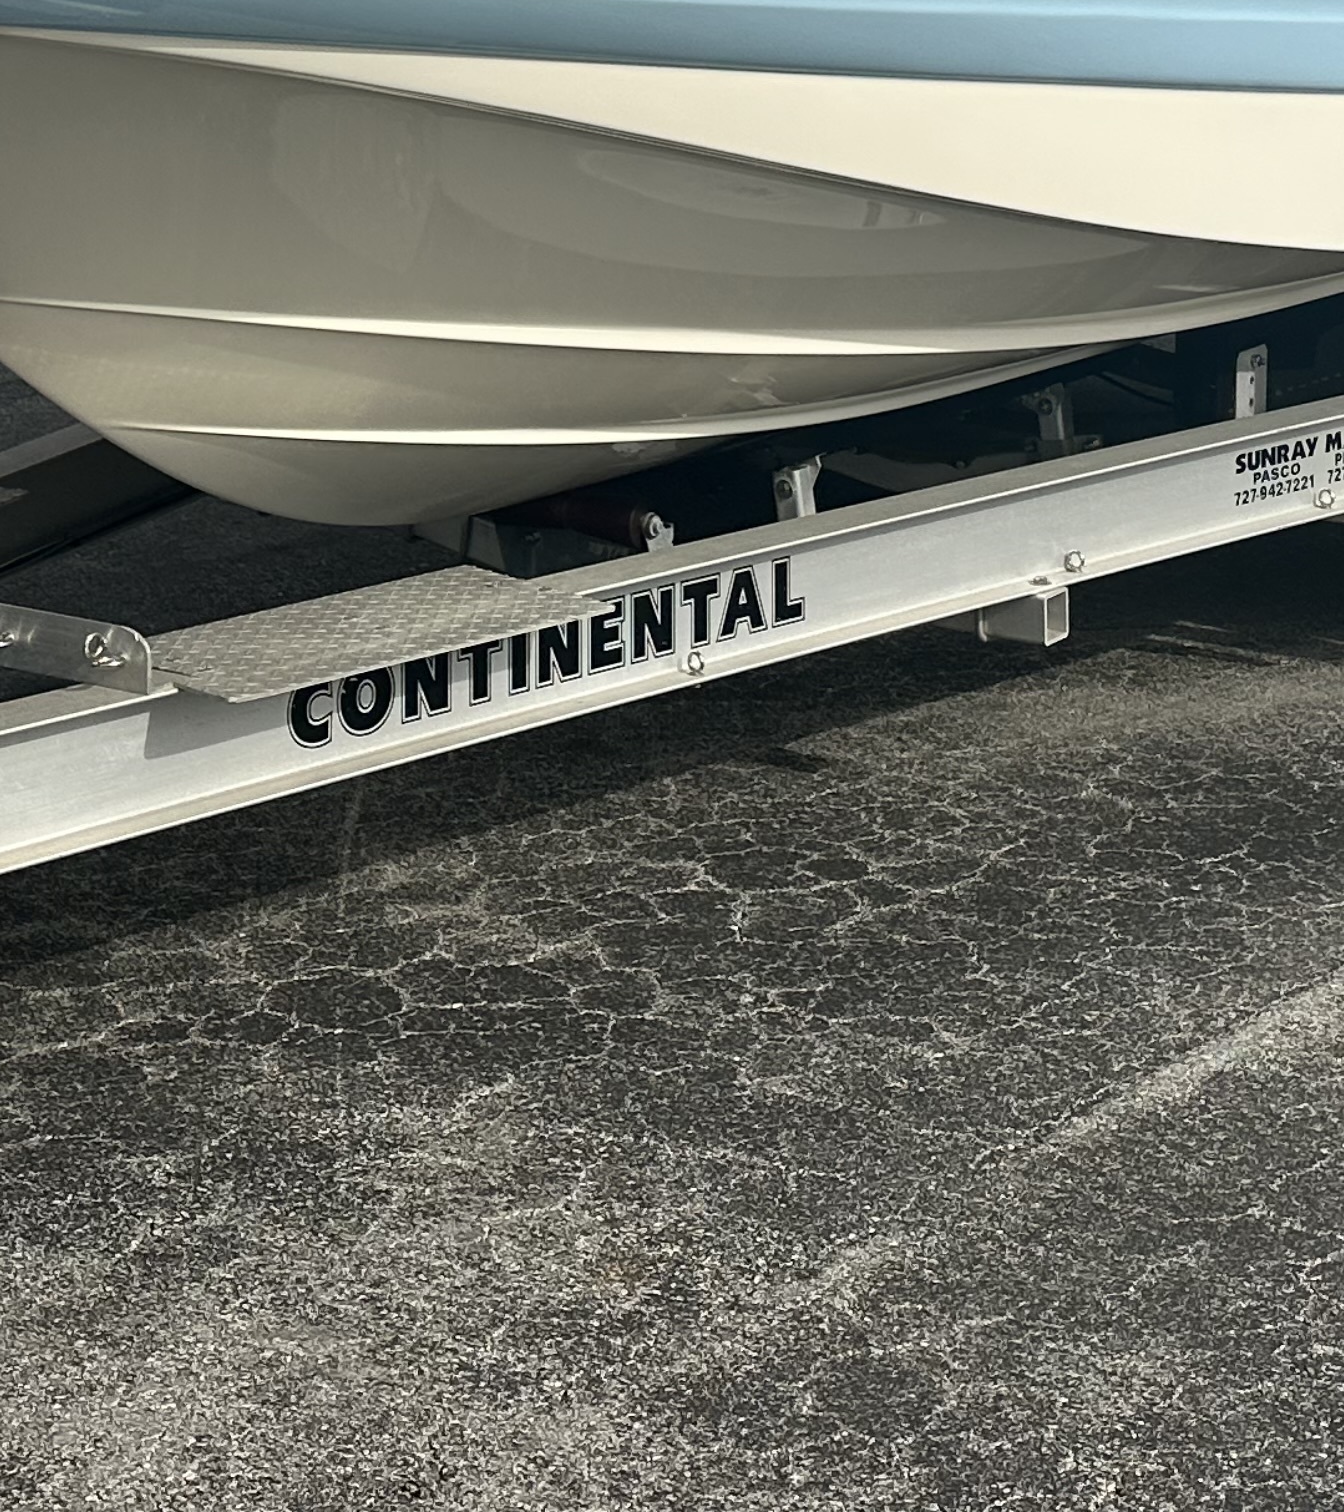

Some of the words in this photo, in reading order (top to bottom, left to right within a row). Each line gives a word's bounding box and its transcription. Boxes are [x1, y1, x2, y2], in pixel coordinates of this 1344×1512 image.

[1235, 436, 1319, 474] SUNRAY
[1234, 474, 1315, 506] 727-942-7221
[1253, 463, 1301, 485] PASCO
[287, 556, 805, 748] CONTINENTAL
